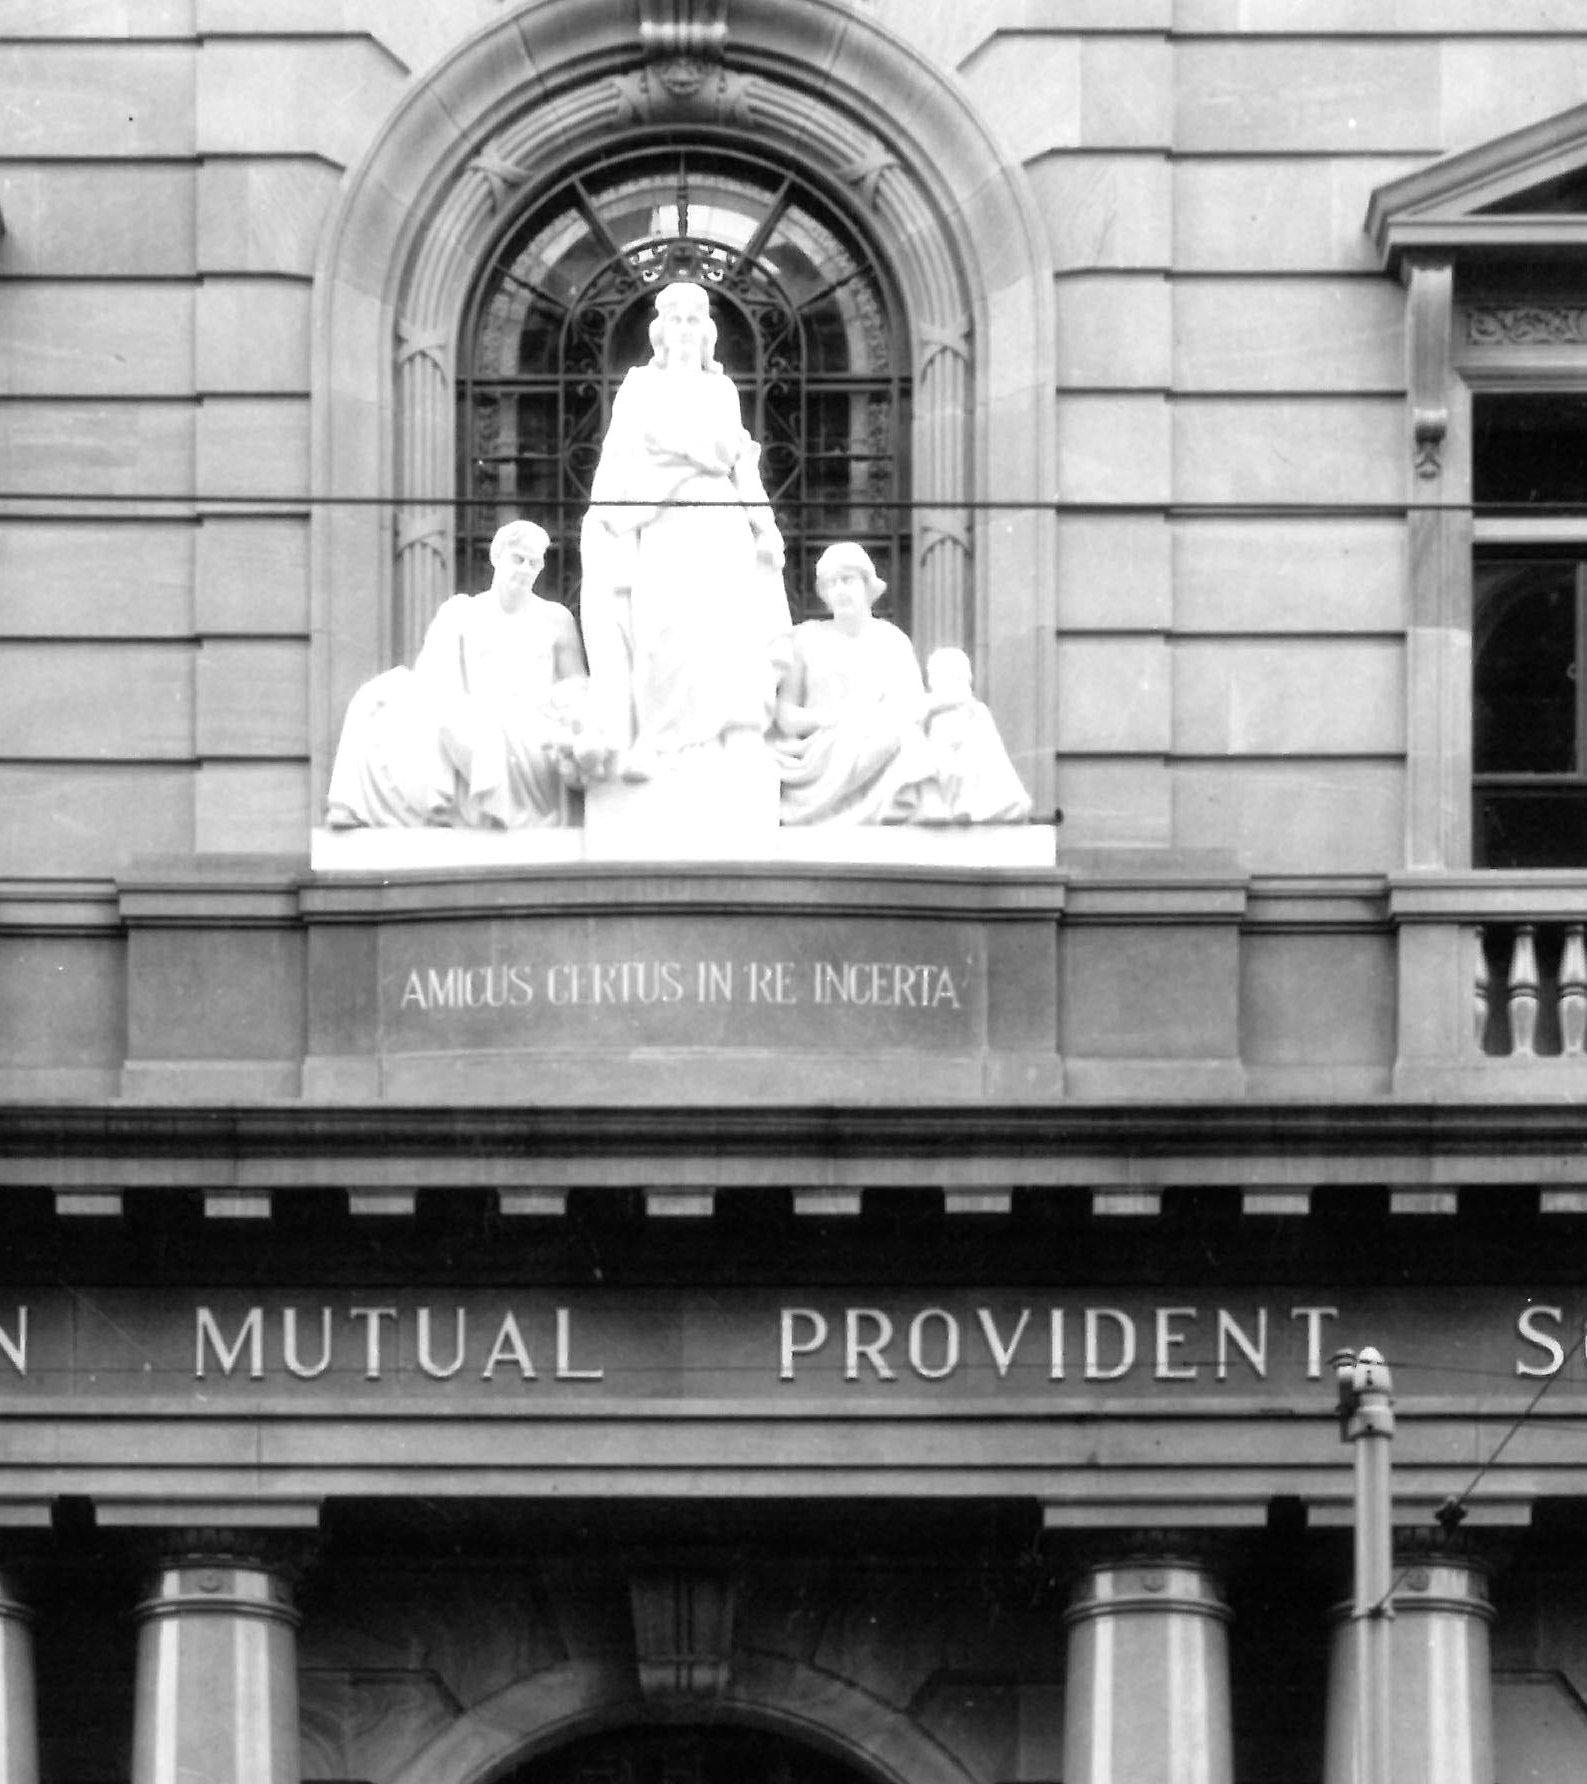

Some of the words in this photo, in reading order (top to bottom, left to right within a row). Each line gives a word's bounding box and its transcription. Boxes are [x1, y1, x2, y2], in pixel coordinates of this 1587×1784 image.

[400, 964, 533, 1010] AMICUS
[546, 960, 683, 1005] CERTUS
[698, 960, 733, 1004] IN
[747, 960, 797, 1005] RE
[814, 960, 961, 1009] INCERTA
[193, 1306, 606, 1381] MUTUAL
[778, 1304, 1341, 1381] PROVIDENT
